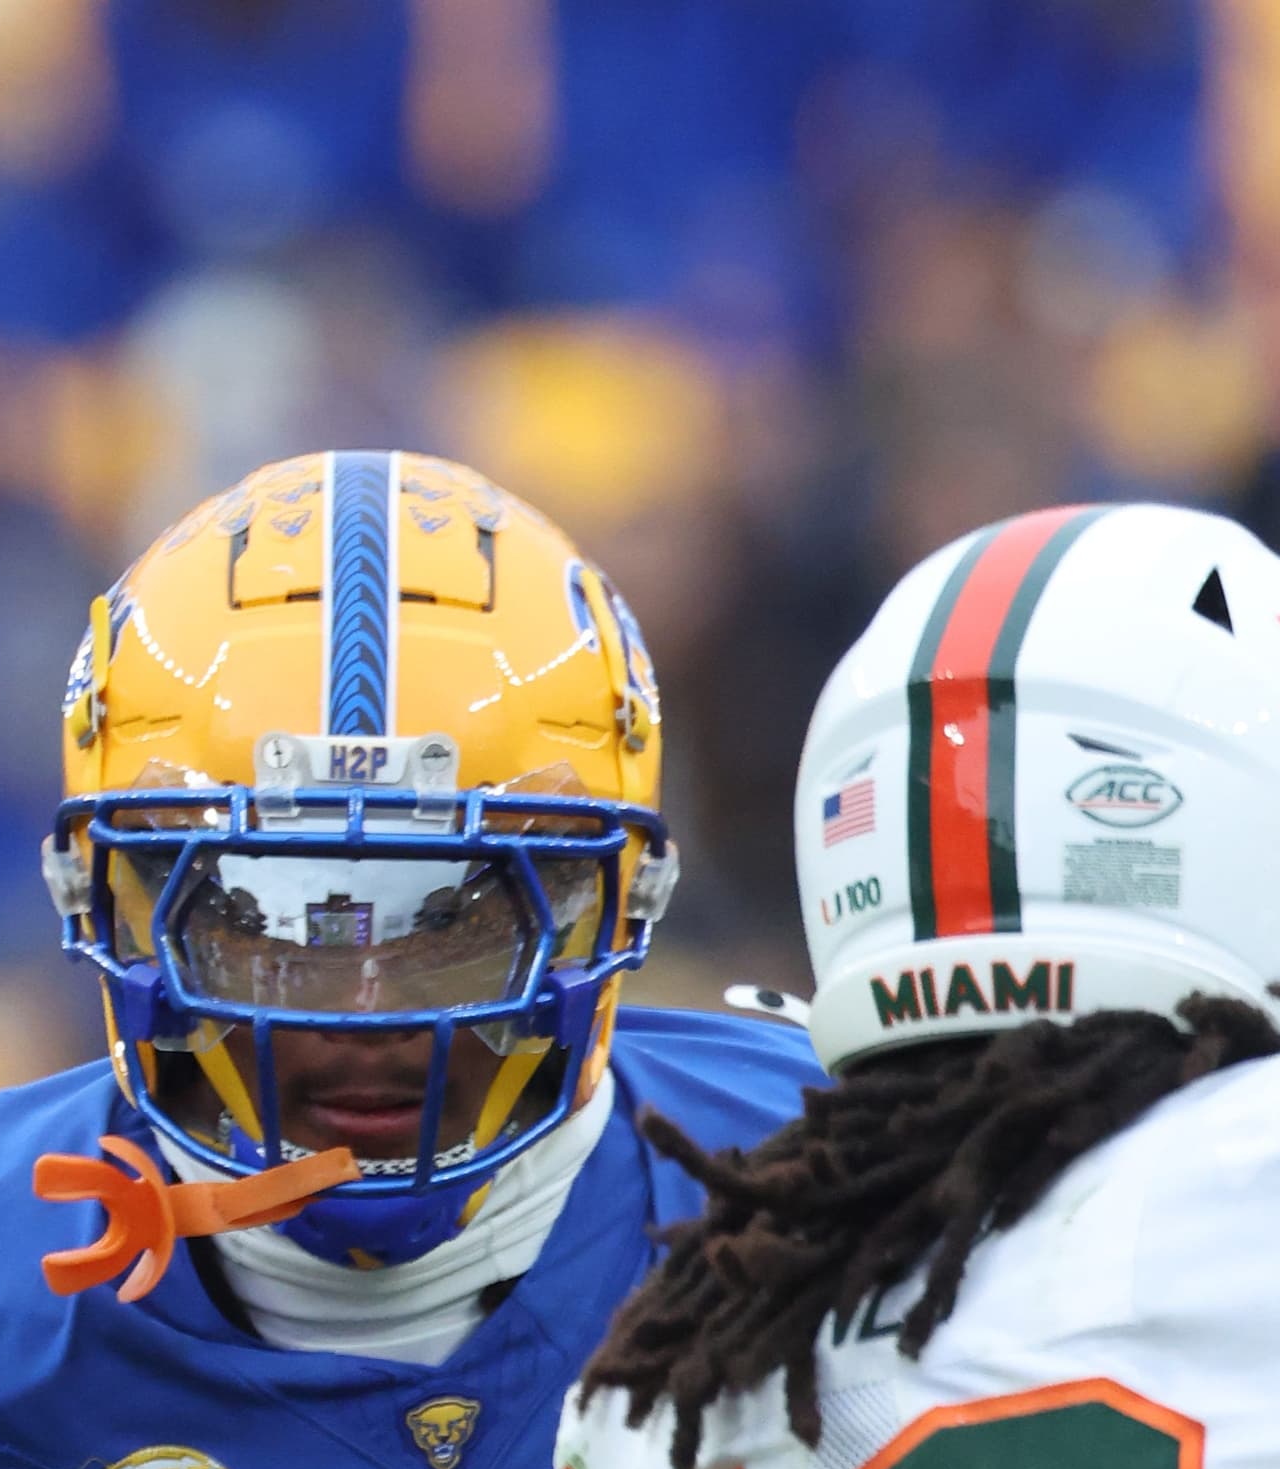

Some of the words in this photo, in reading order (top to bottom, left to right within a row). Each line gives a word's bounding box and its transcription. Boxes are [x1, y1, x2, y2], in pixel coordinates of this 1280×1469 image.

[329, 745, 388, 781] H2P
[1085, 780, 1164, 804] ACC
[846, 876, 881, 914] 100
[870, 961, 1074, 1028] MIAMI
